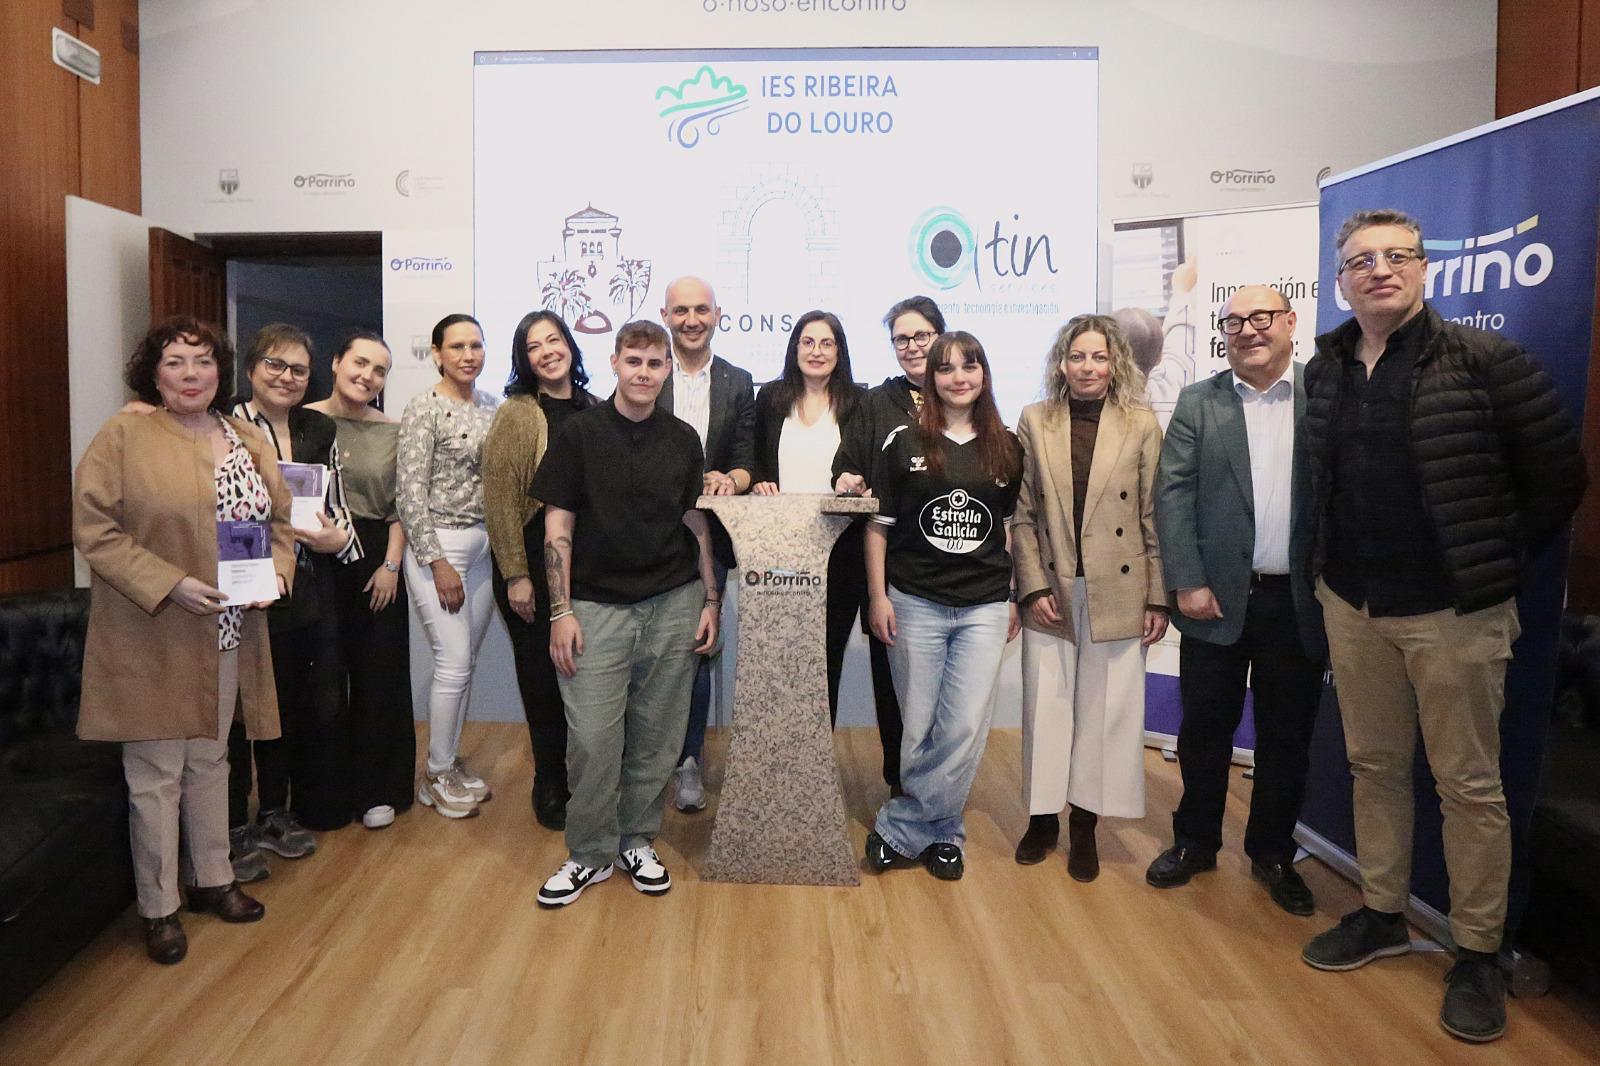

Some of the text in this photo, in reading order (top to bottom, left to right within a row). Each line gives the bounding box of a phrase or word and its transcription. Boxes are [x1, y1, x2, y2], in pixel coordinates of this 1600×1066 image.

[761, 75, 898, 97] IES RIBEIRA
[767, 111, 893, 134] DO LOURO
[932, 506, 982, 524] Estrella
[932, 521, 978, 538] Galicia
